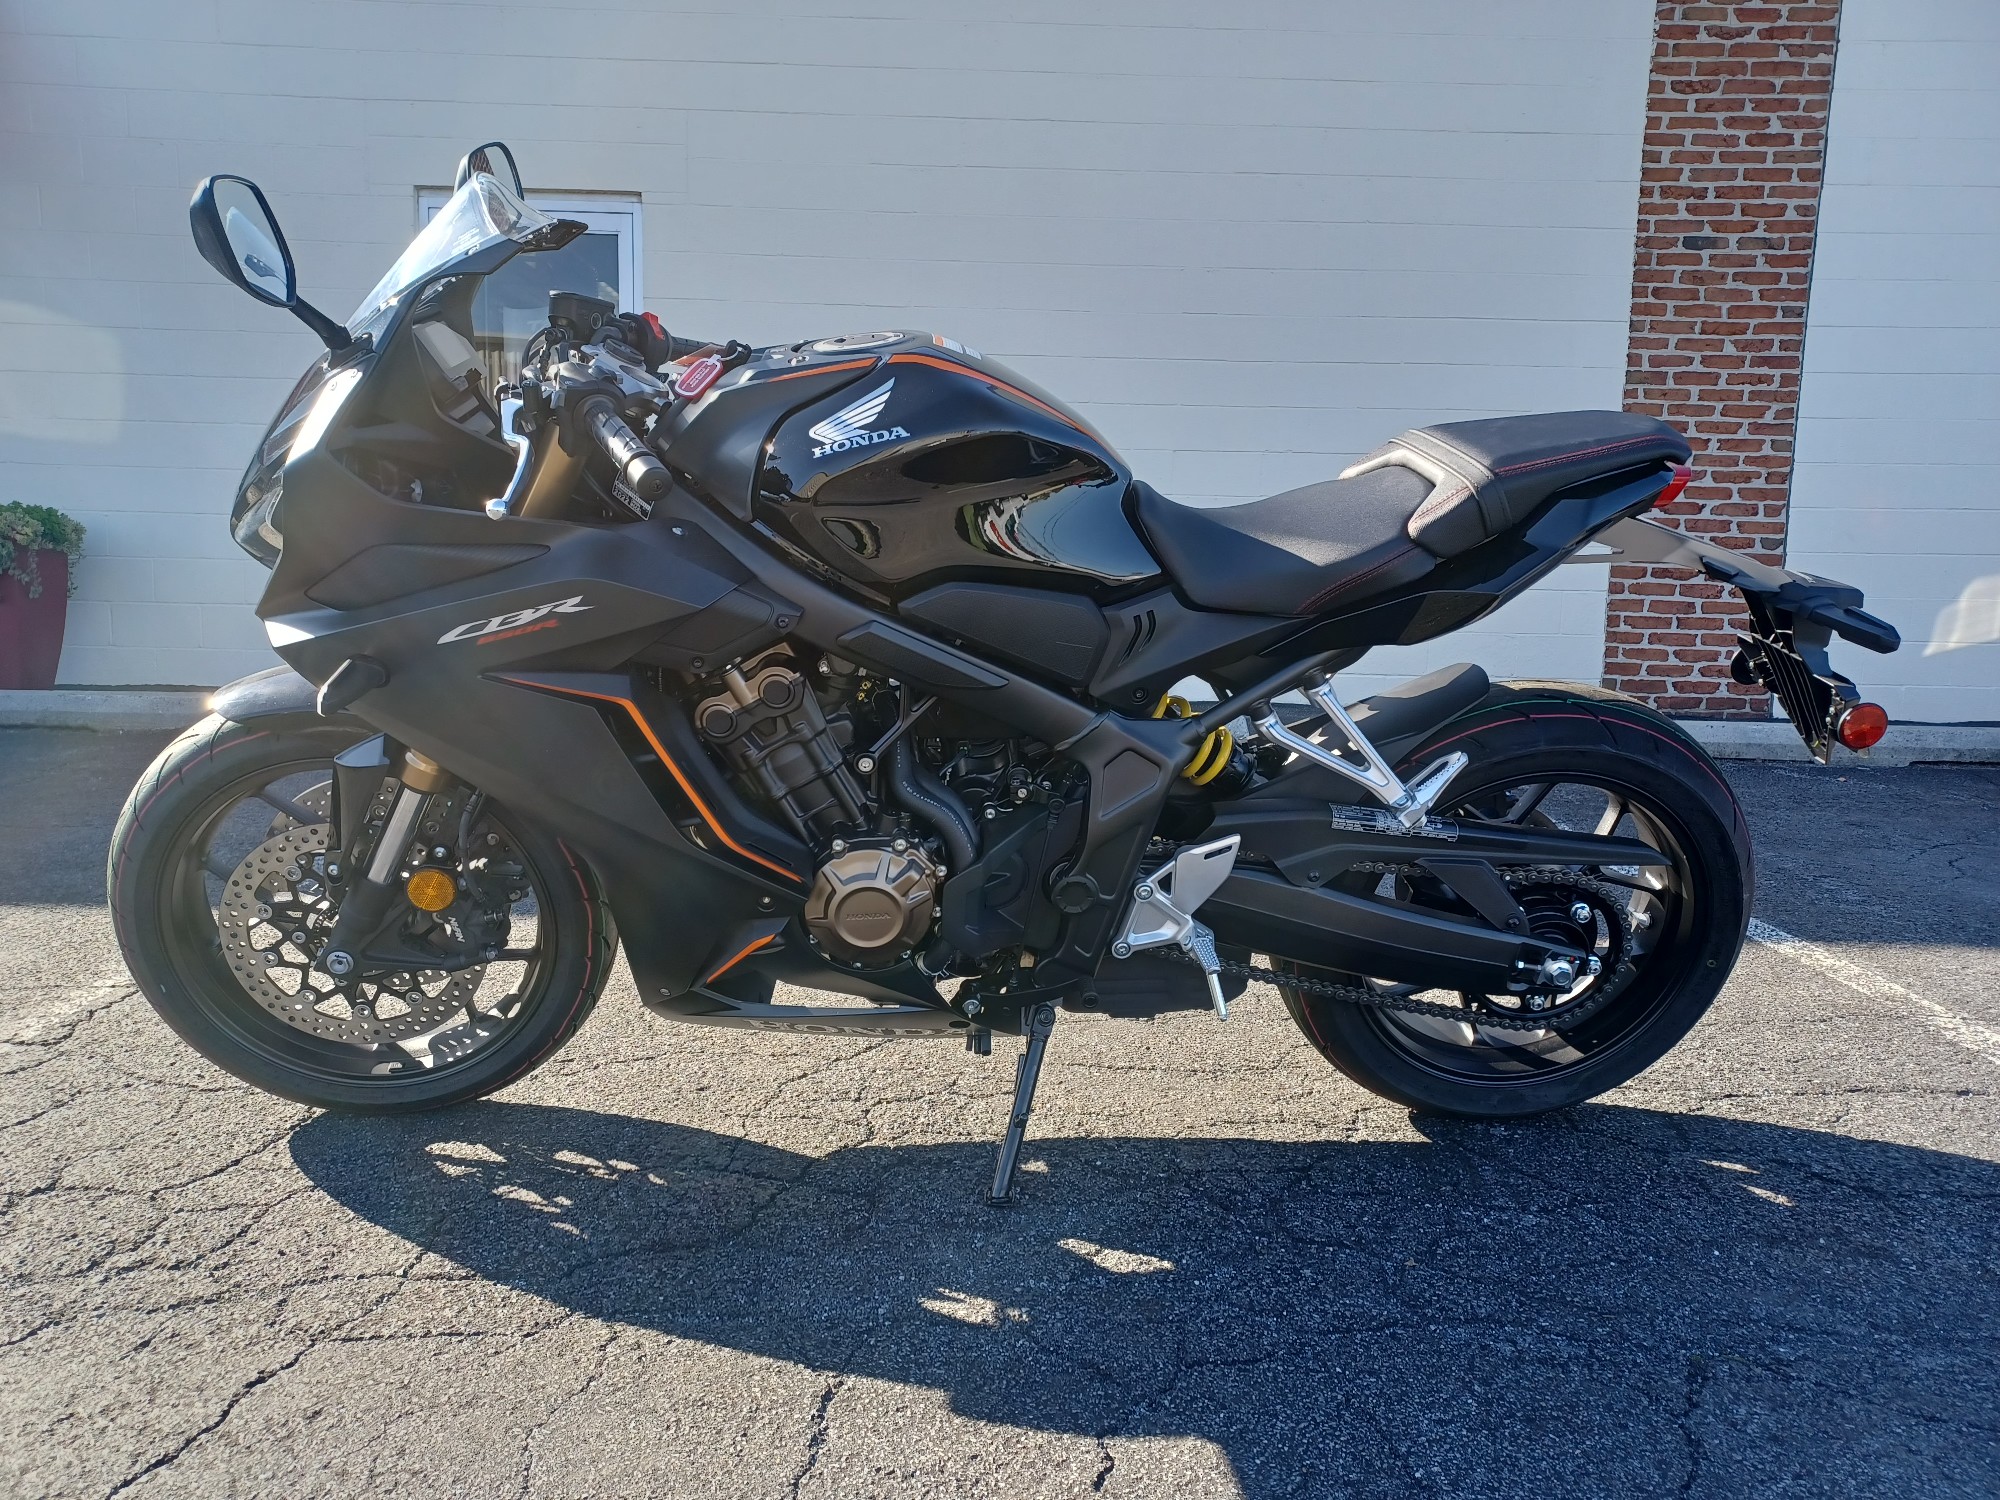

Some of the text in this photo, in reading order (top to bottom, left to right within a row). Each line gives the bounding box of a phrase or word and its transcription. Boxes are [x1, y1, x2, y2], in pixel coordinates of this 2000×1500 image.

[811, 426, 910, 458] HONDA
[436, 595, 595, 645] CBR
[846, 912, 893, 921] HONDA
[743, 1019, 968, 1036] HONDA
